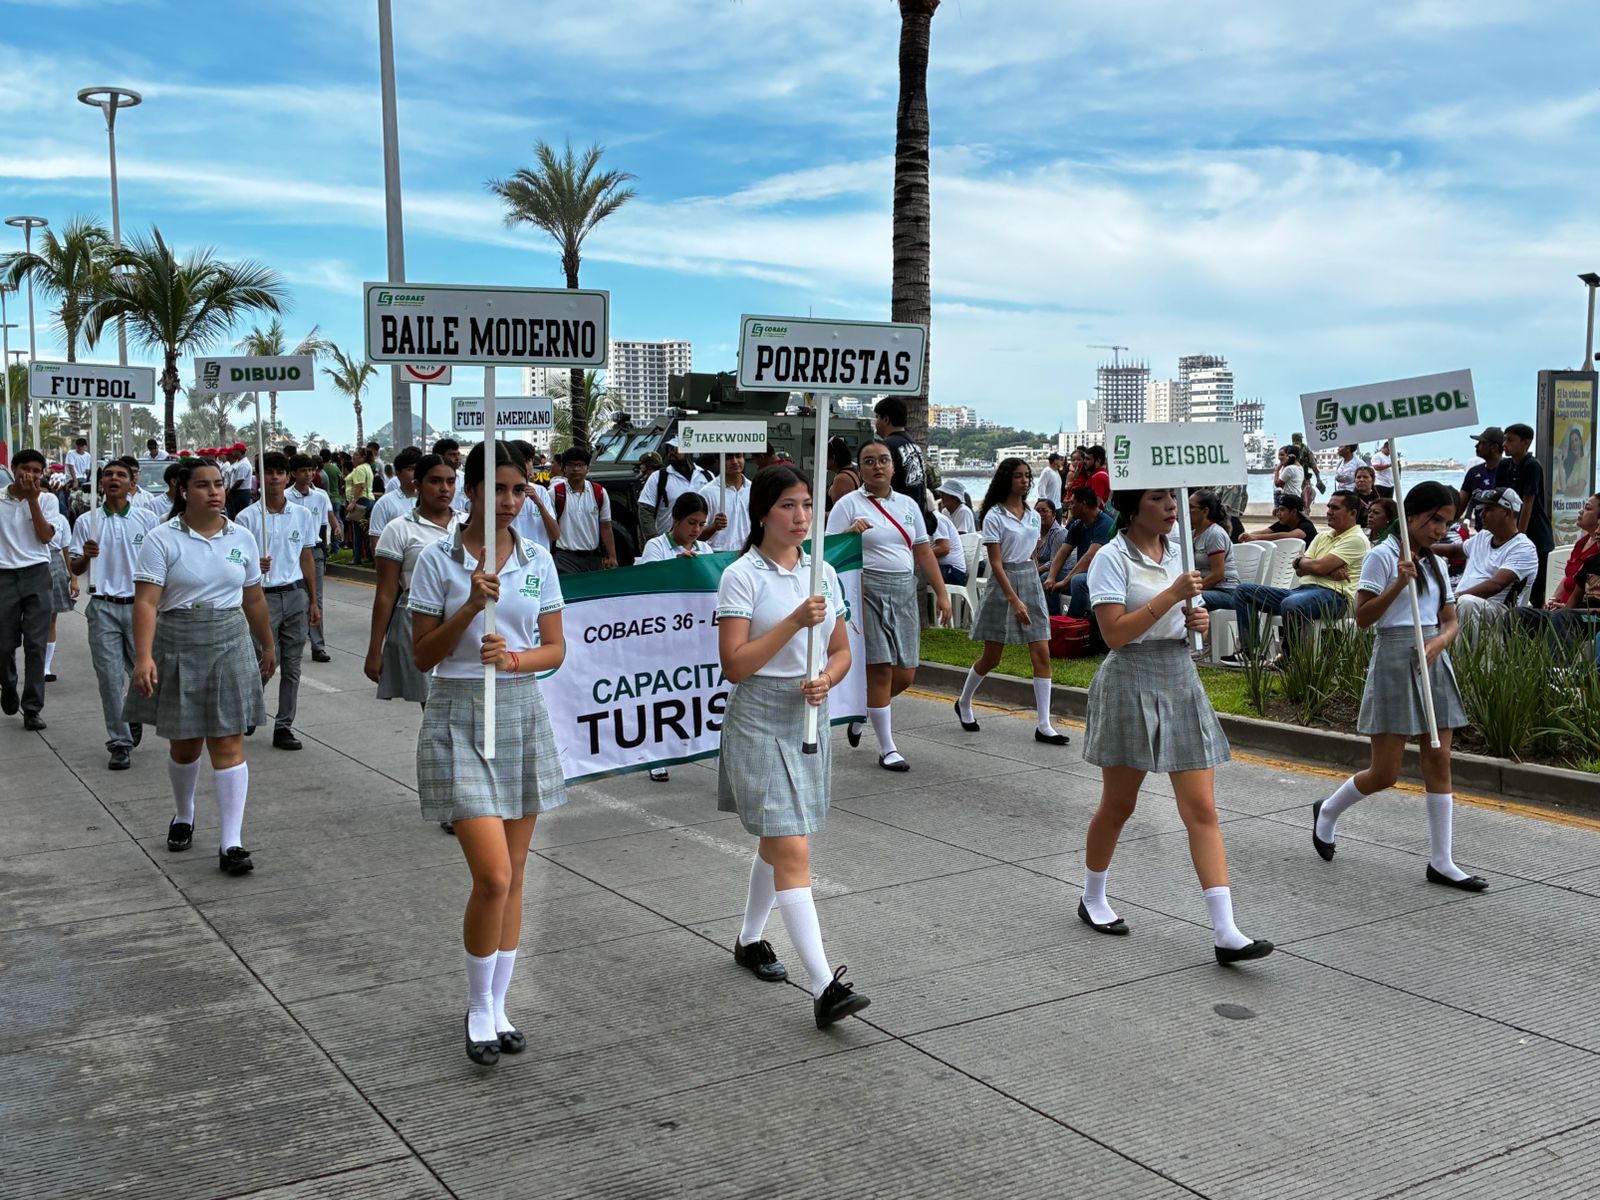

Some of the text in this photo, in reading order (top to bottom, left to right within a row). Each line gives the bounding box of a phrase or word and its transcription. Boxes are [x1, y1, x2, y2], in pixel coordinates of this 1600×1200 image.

[381, 314, 596, 358] BAILE MODERNO
[755, 345, 911, 386] PORRISTAS
[230, 366, 300, 382] DIBUJO
[51, 376, 136, 399] FUTBOL
[205, 381, 218, 390] 36
[1340, 390, 1469, 426] VOLEIBOL
[496, 410, 550, 425] AMERICANO
[1315, 422, 1338, 431] COBAES
[694, 433, 766, 443] TAEKWONDO
[1319, 429, 1338, 442] 36
[1150, 445, 1230, 466] BEISBOL
[1114, 465, 1129, 478] 36
[1553, 500, 1565, 510] Más
[1566, 502, 1581, 510] como
[584, 616, 666, 644] COBAES
[672, 613, 694, 631] 36
